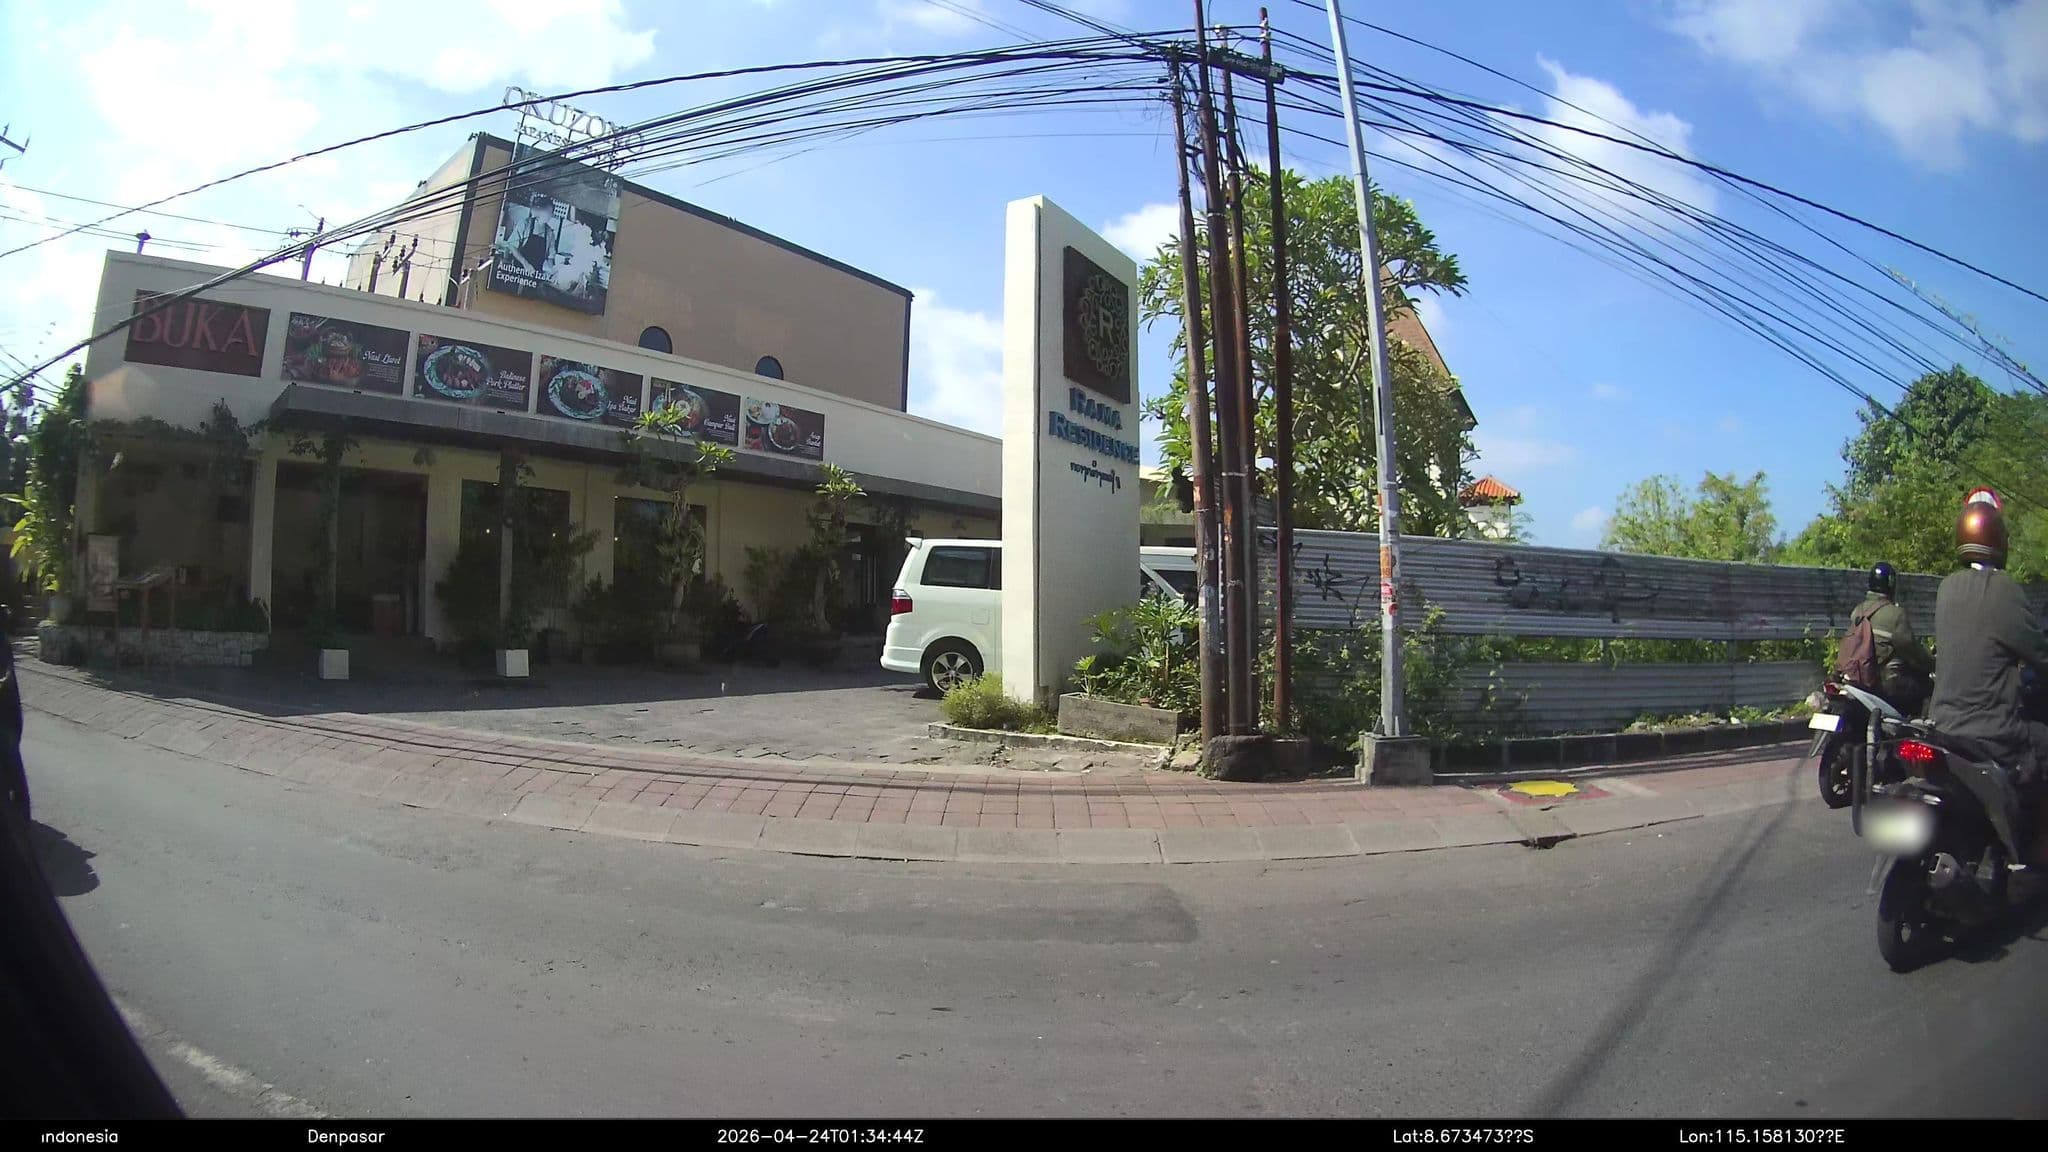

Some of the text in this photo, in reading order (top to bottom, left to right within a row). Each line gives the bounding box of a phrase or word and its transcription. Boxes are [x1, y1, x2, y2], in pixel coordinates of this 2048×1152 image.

[514, 122, 578, 148] JAPANES
[496, 270, 538, 288] Experience
[497, 261, 535, 278] Authentic
[132, 299, 258, 358] BUKA
[1069, 387, 1122, 431] RAMA
[1048, 411, 1140, 465] RESIDENCE
